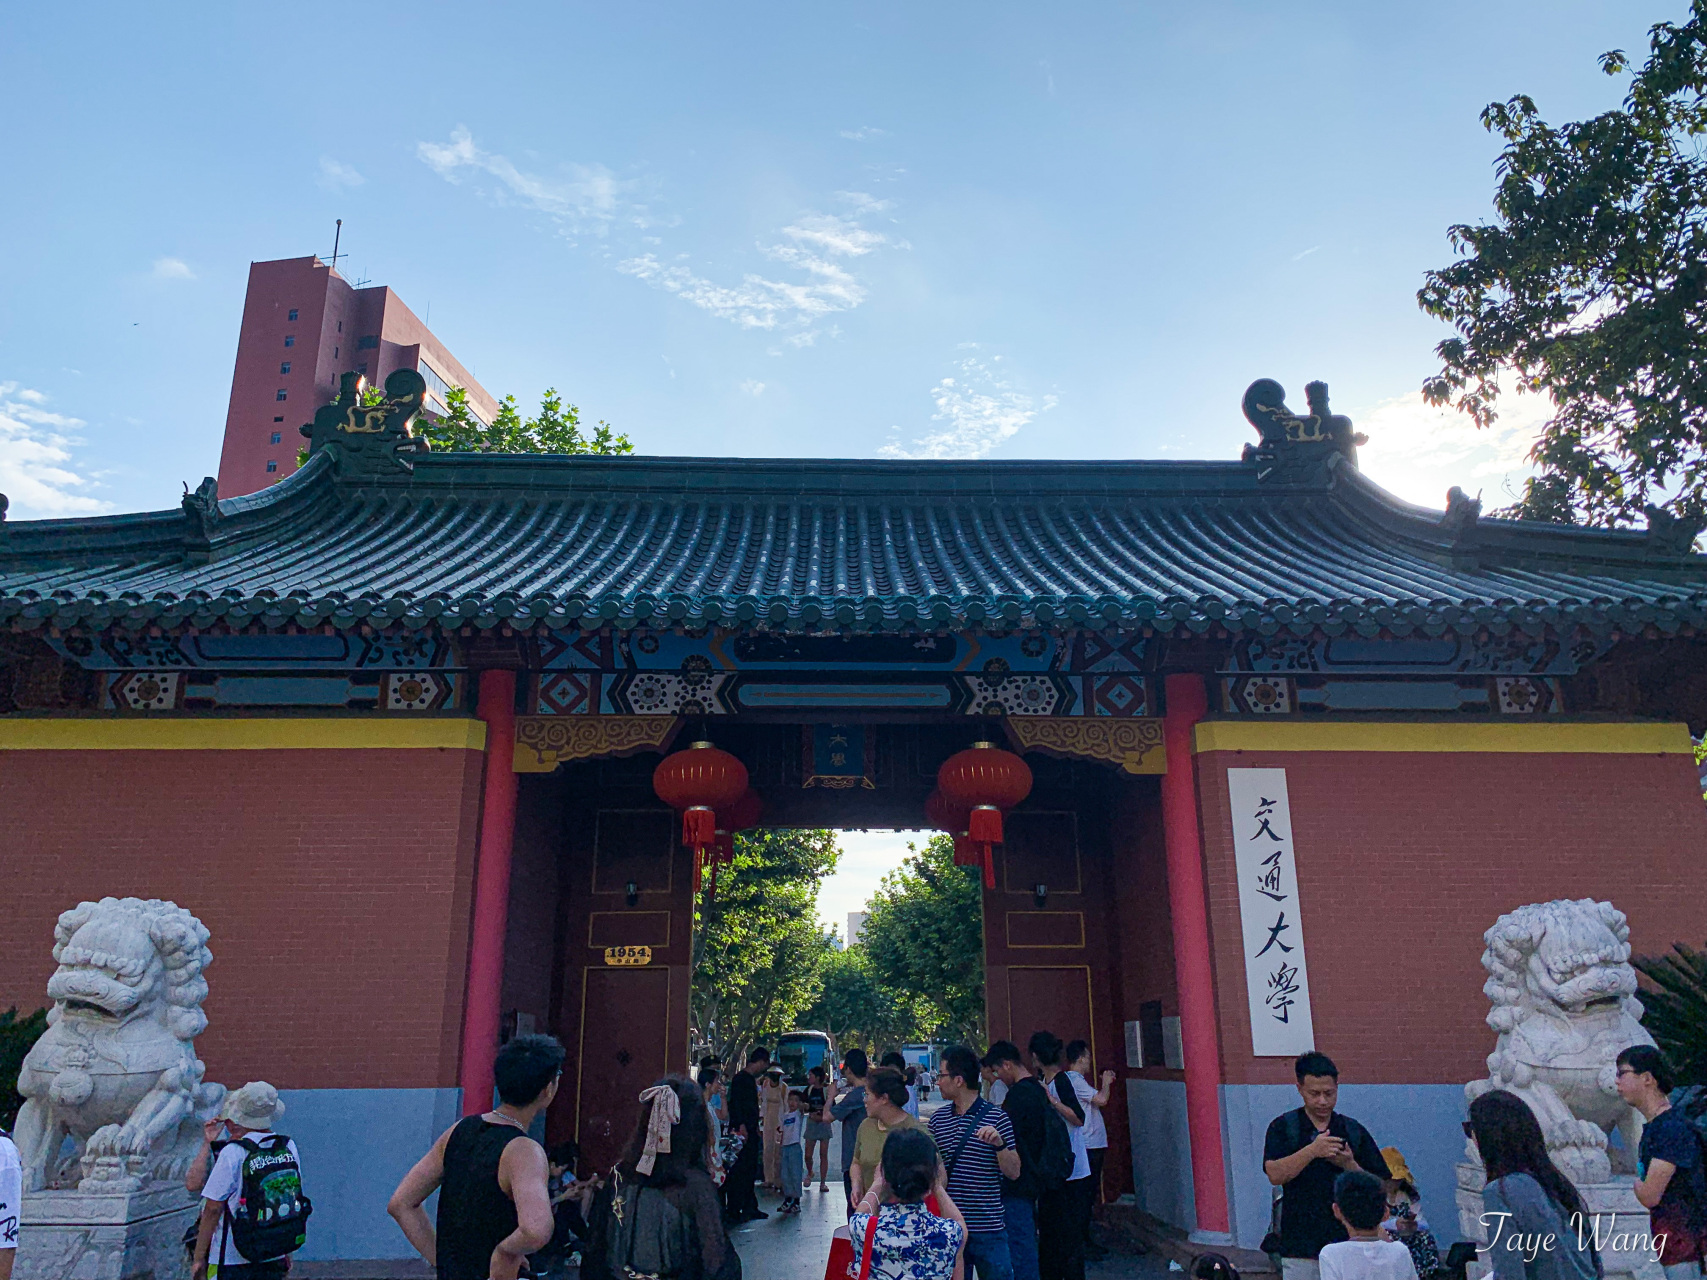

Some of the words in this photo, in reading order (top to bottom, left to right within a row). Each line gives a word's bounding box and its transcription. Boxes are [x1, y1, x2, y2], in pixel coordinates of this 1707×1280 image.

[609, 947, 646, 958] 1954
[1250, 796, 1300, 1024] 交通大學
